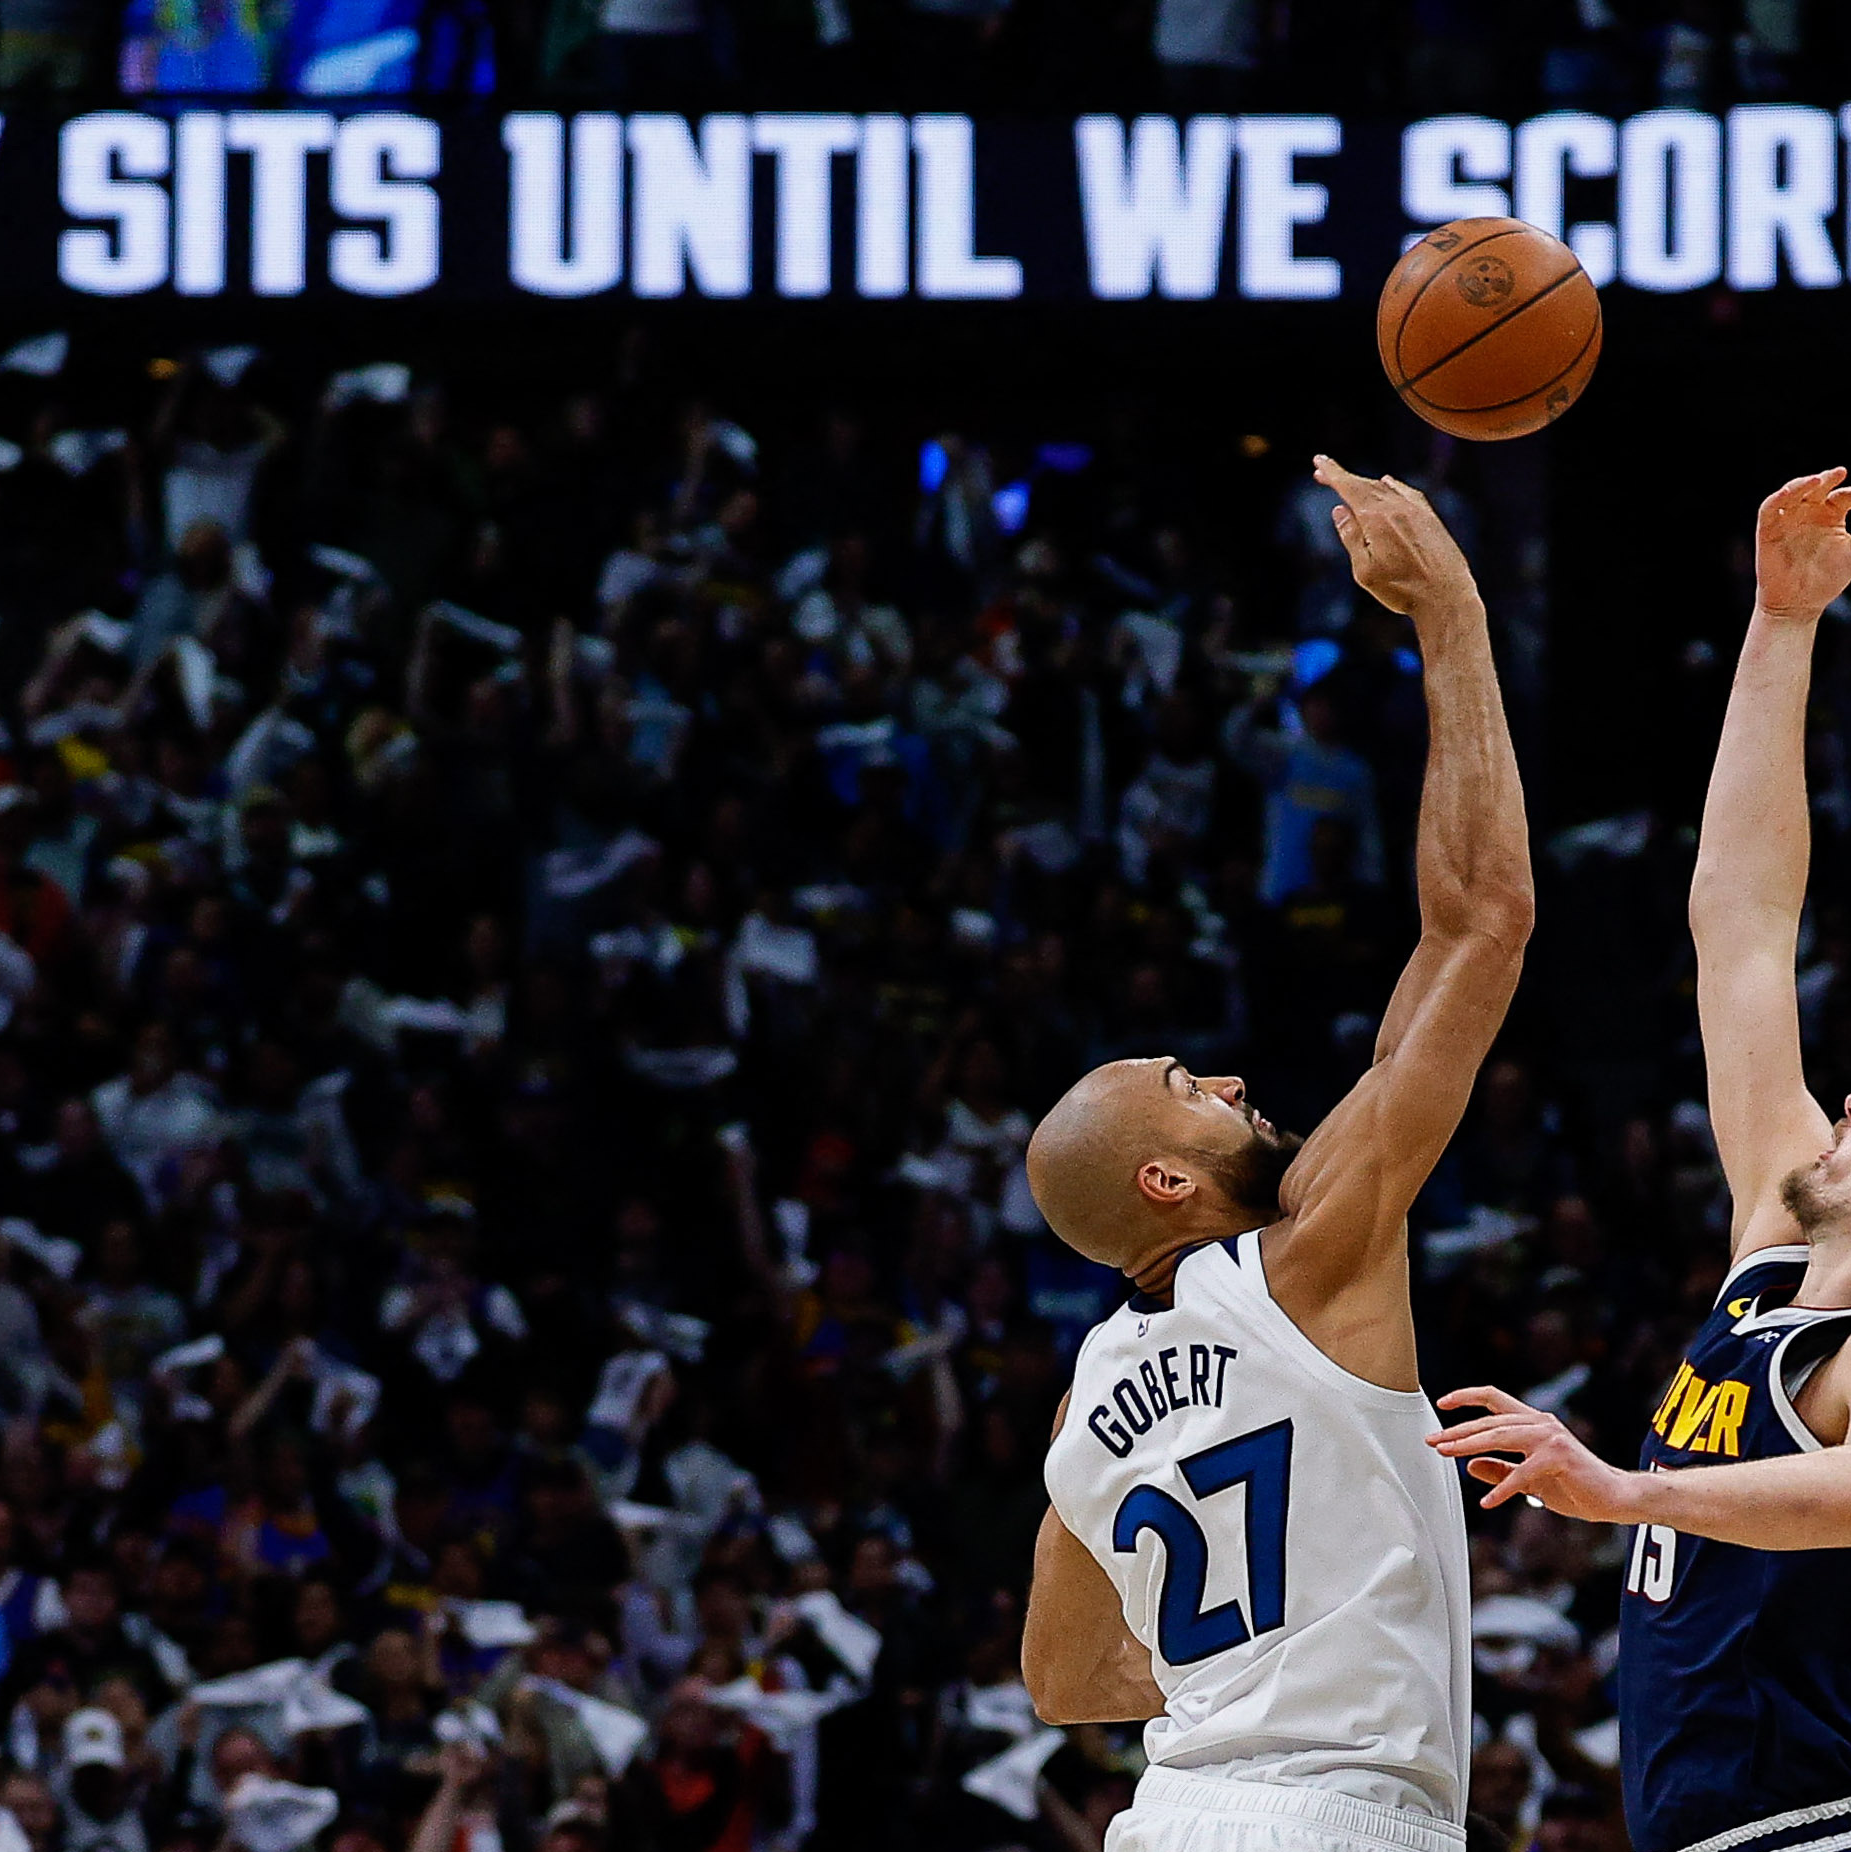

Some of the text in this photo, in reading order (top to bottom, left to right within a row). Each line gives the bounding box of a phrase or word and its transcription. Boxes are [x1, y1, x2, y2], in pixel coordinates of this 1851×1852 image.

[56, 111, 440, 297] SITS
[502, 111, 1023, 298] UNTIL
[1075, 113, 1343, 299] WE
[1088, 1343, 1238, 1459] GOBERT
[1112, 1416, 1294, 1667] 27
